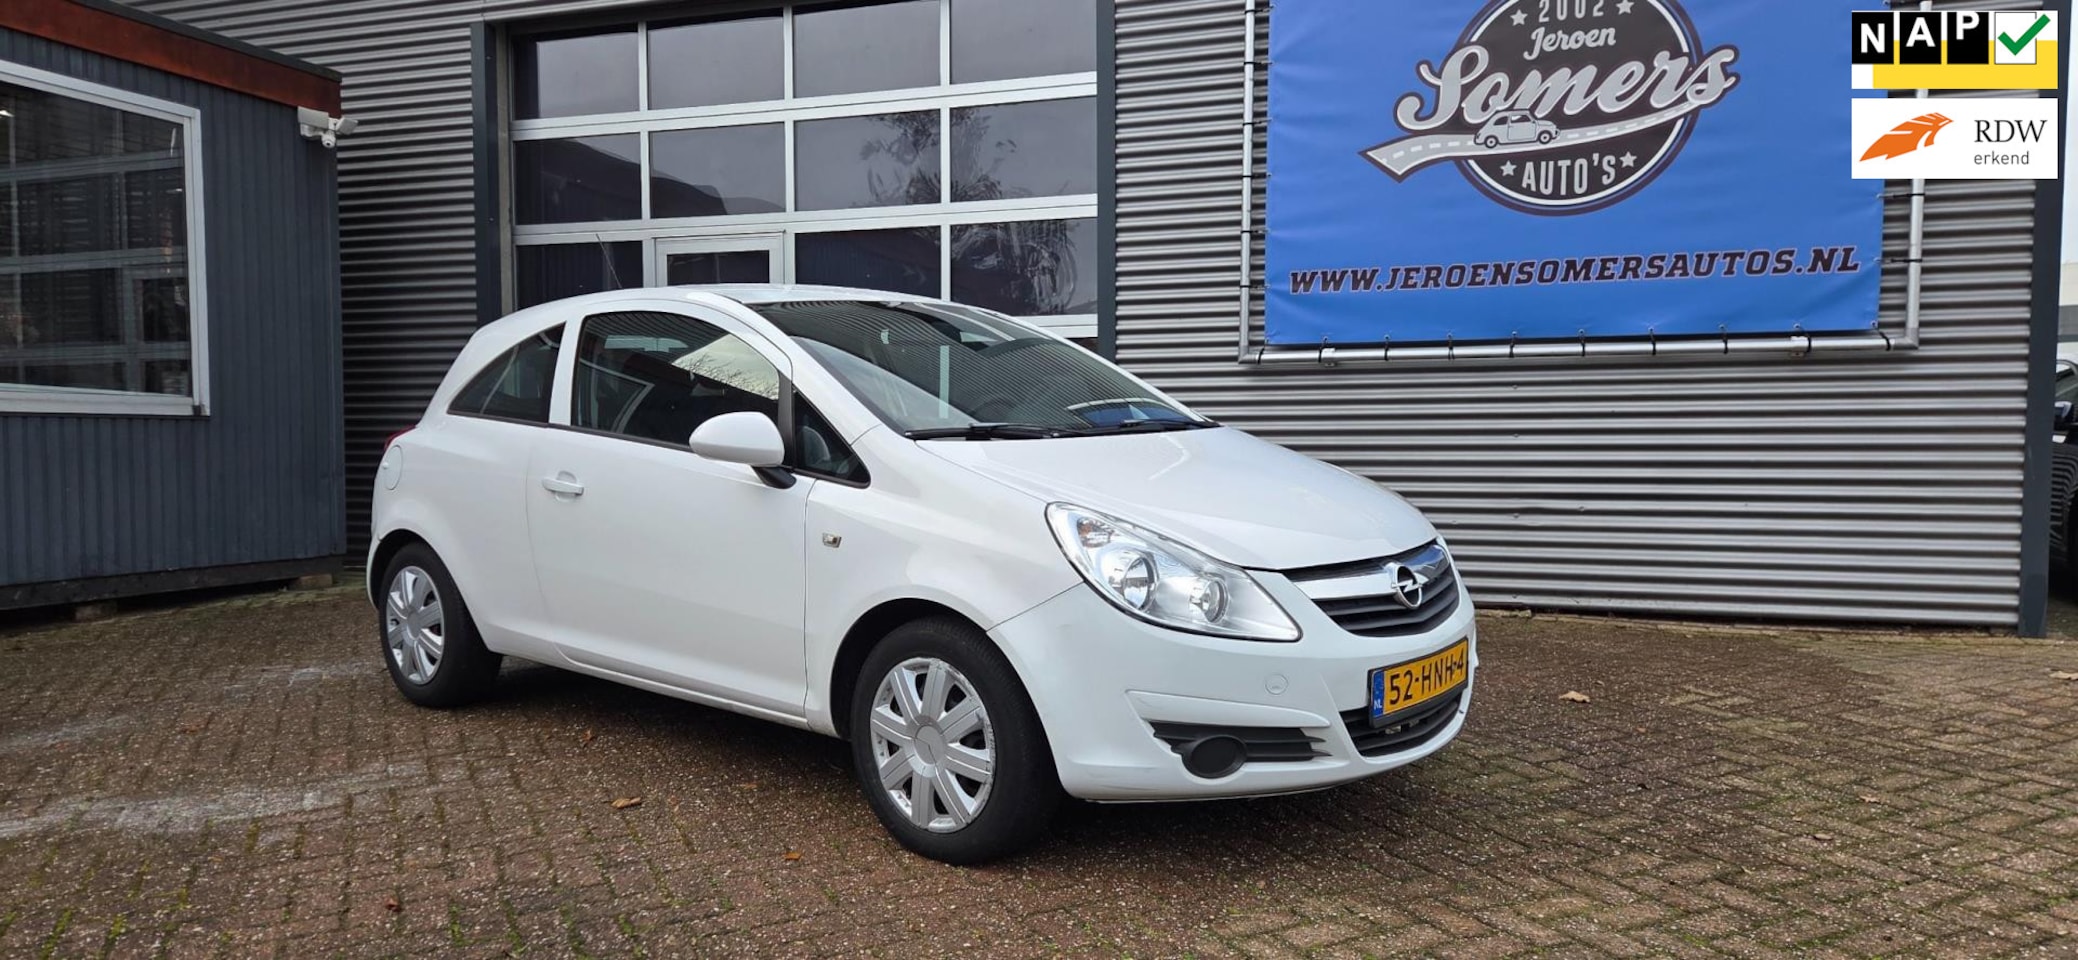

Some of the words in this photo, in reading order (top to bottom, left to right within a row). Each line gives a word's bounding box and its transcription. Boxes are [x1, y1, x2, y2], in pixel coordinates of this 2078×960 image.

[1523, 26, 1616, 60] Jeroen
[1398, 45, 1737, 130] Somers
[1521, 153, 1617, 196] AUTO'S
[1289, 245, 1860, 294] WWW.JEROENSOMERSAUTOS.NL
[1389, 647, 1464, 706] 52-HNH-4
[1373, 698, 1383, 710] NL
